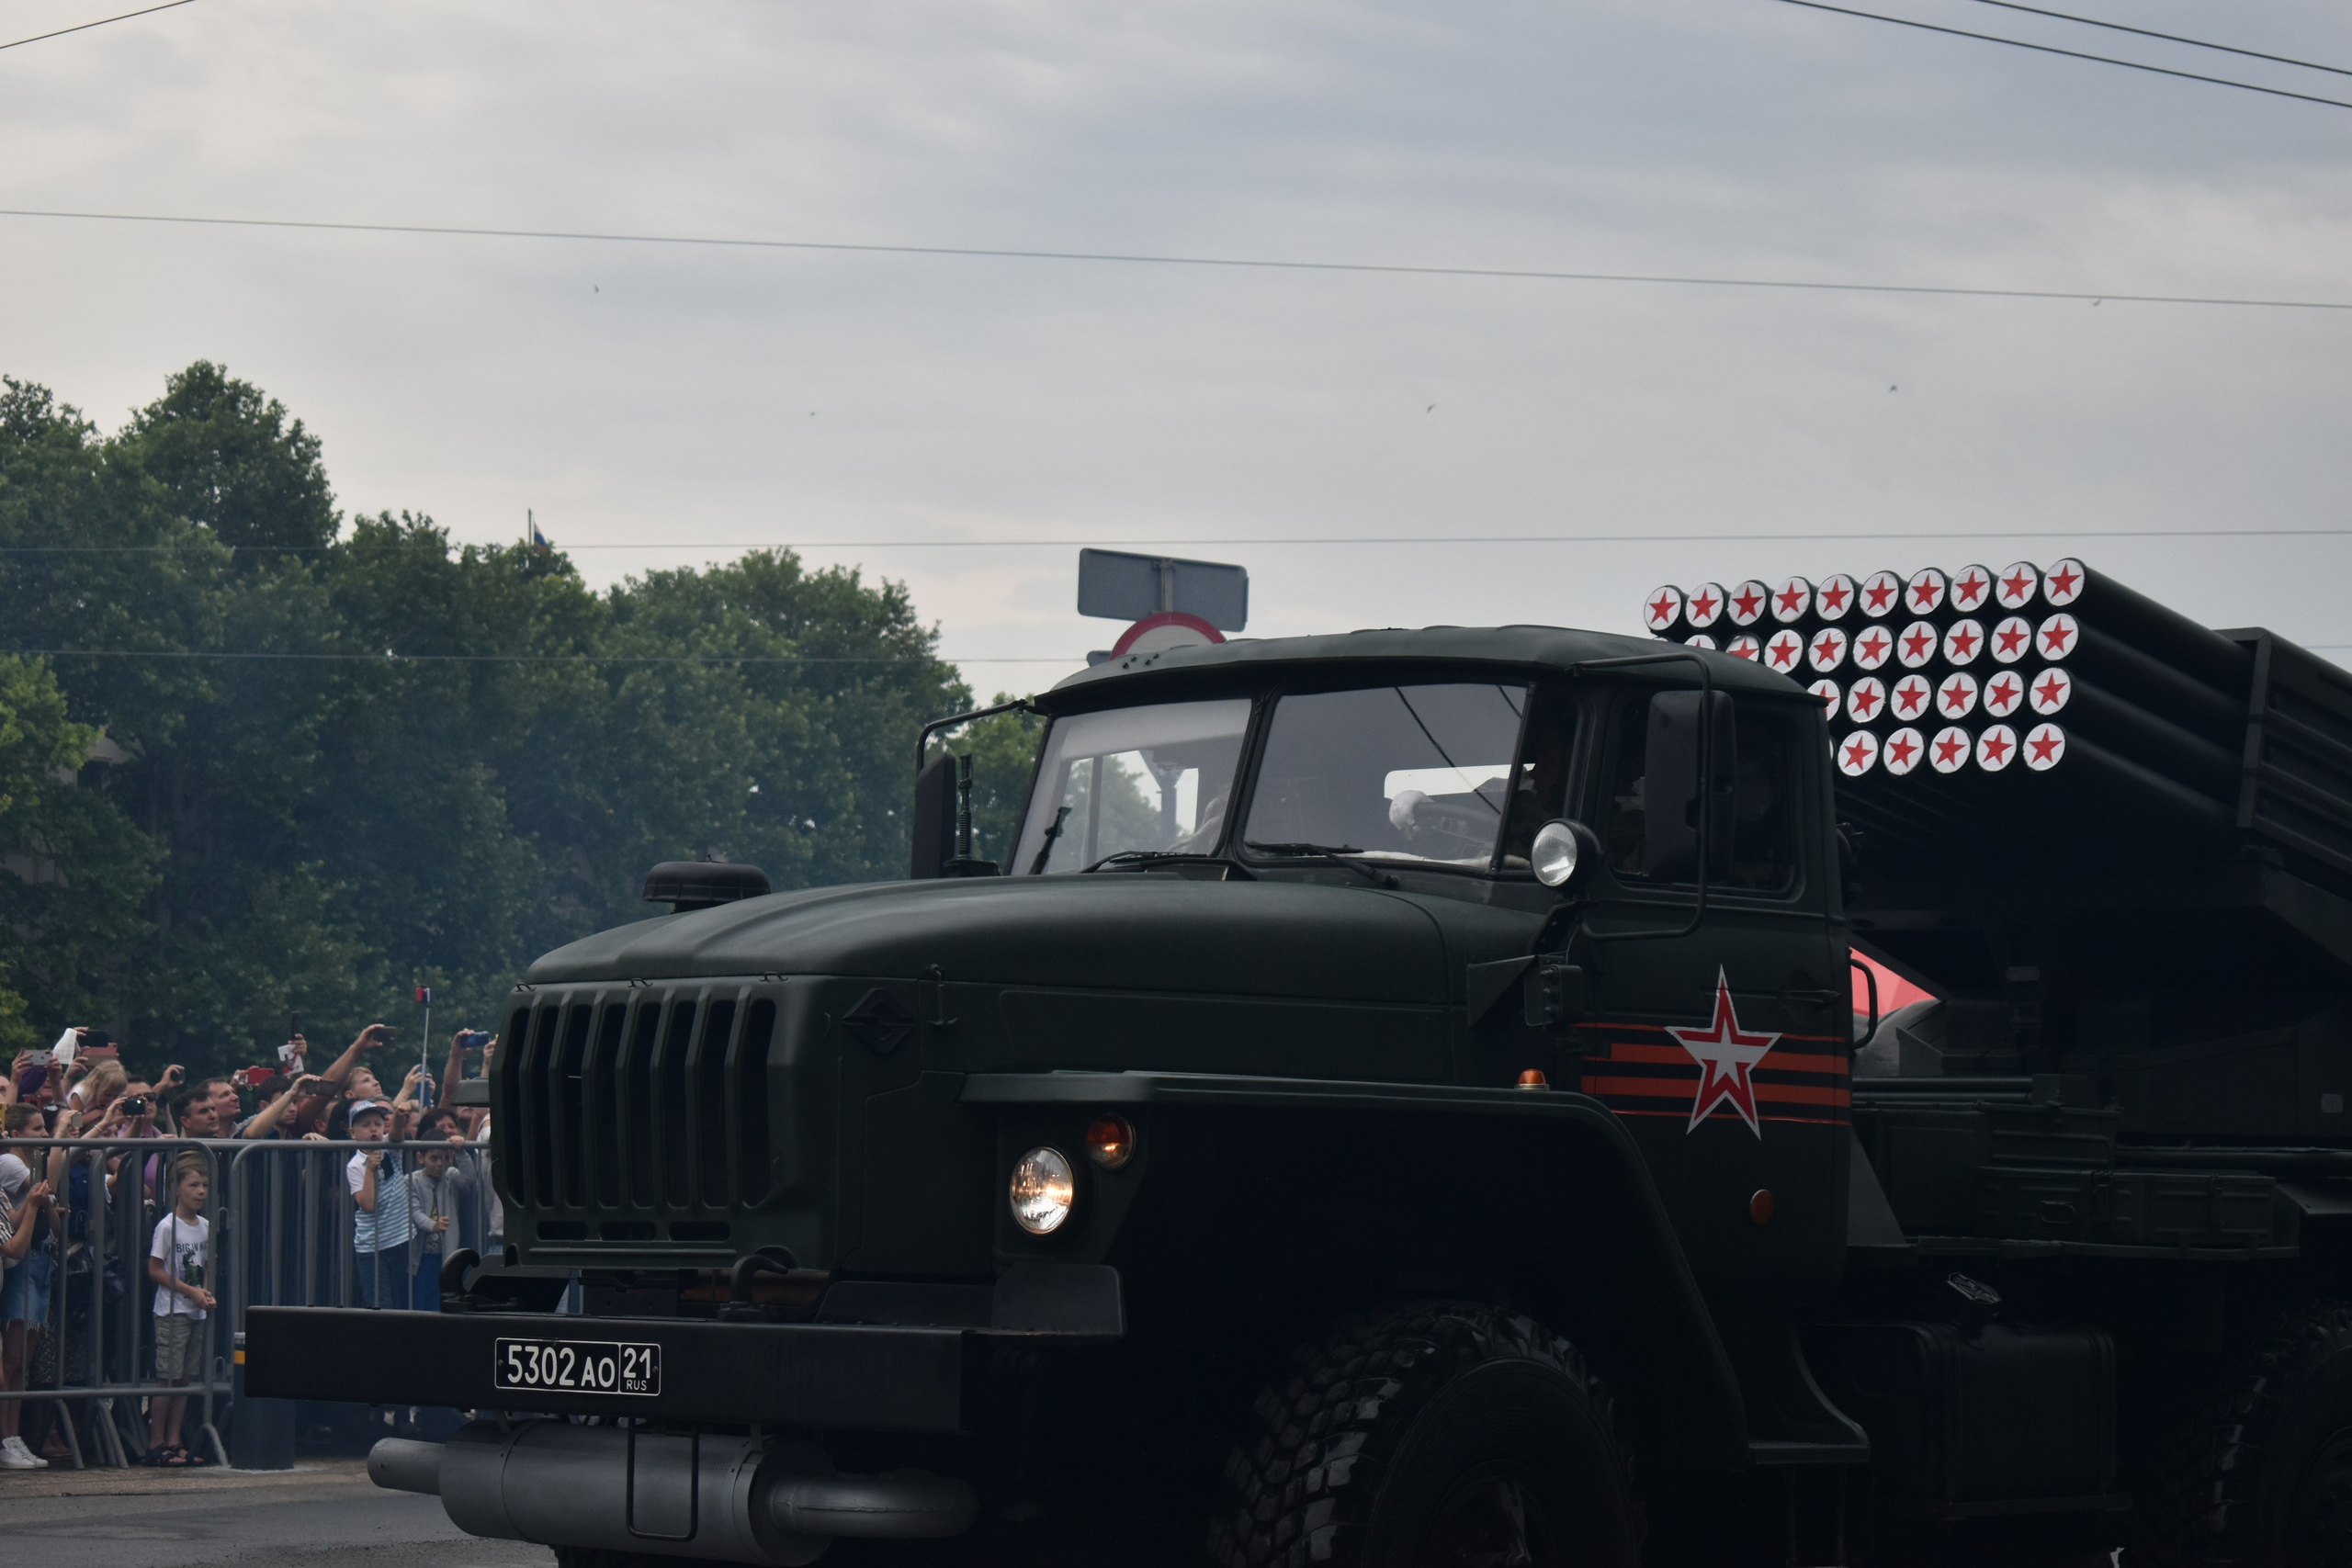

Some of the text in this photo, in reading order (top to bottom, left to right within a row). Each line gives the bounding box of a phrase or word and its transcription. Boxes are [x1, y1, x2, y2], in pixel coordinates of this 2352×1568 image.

[175, 1243, 190, 1253] BIG
[623, 1348, 650, 1379] 21
[626, 1380, 647, 1391] RUS
